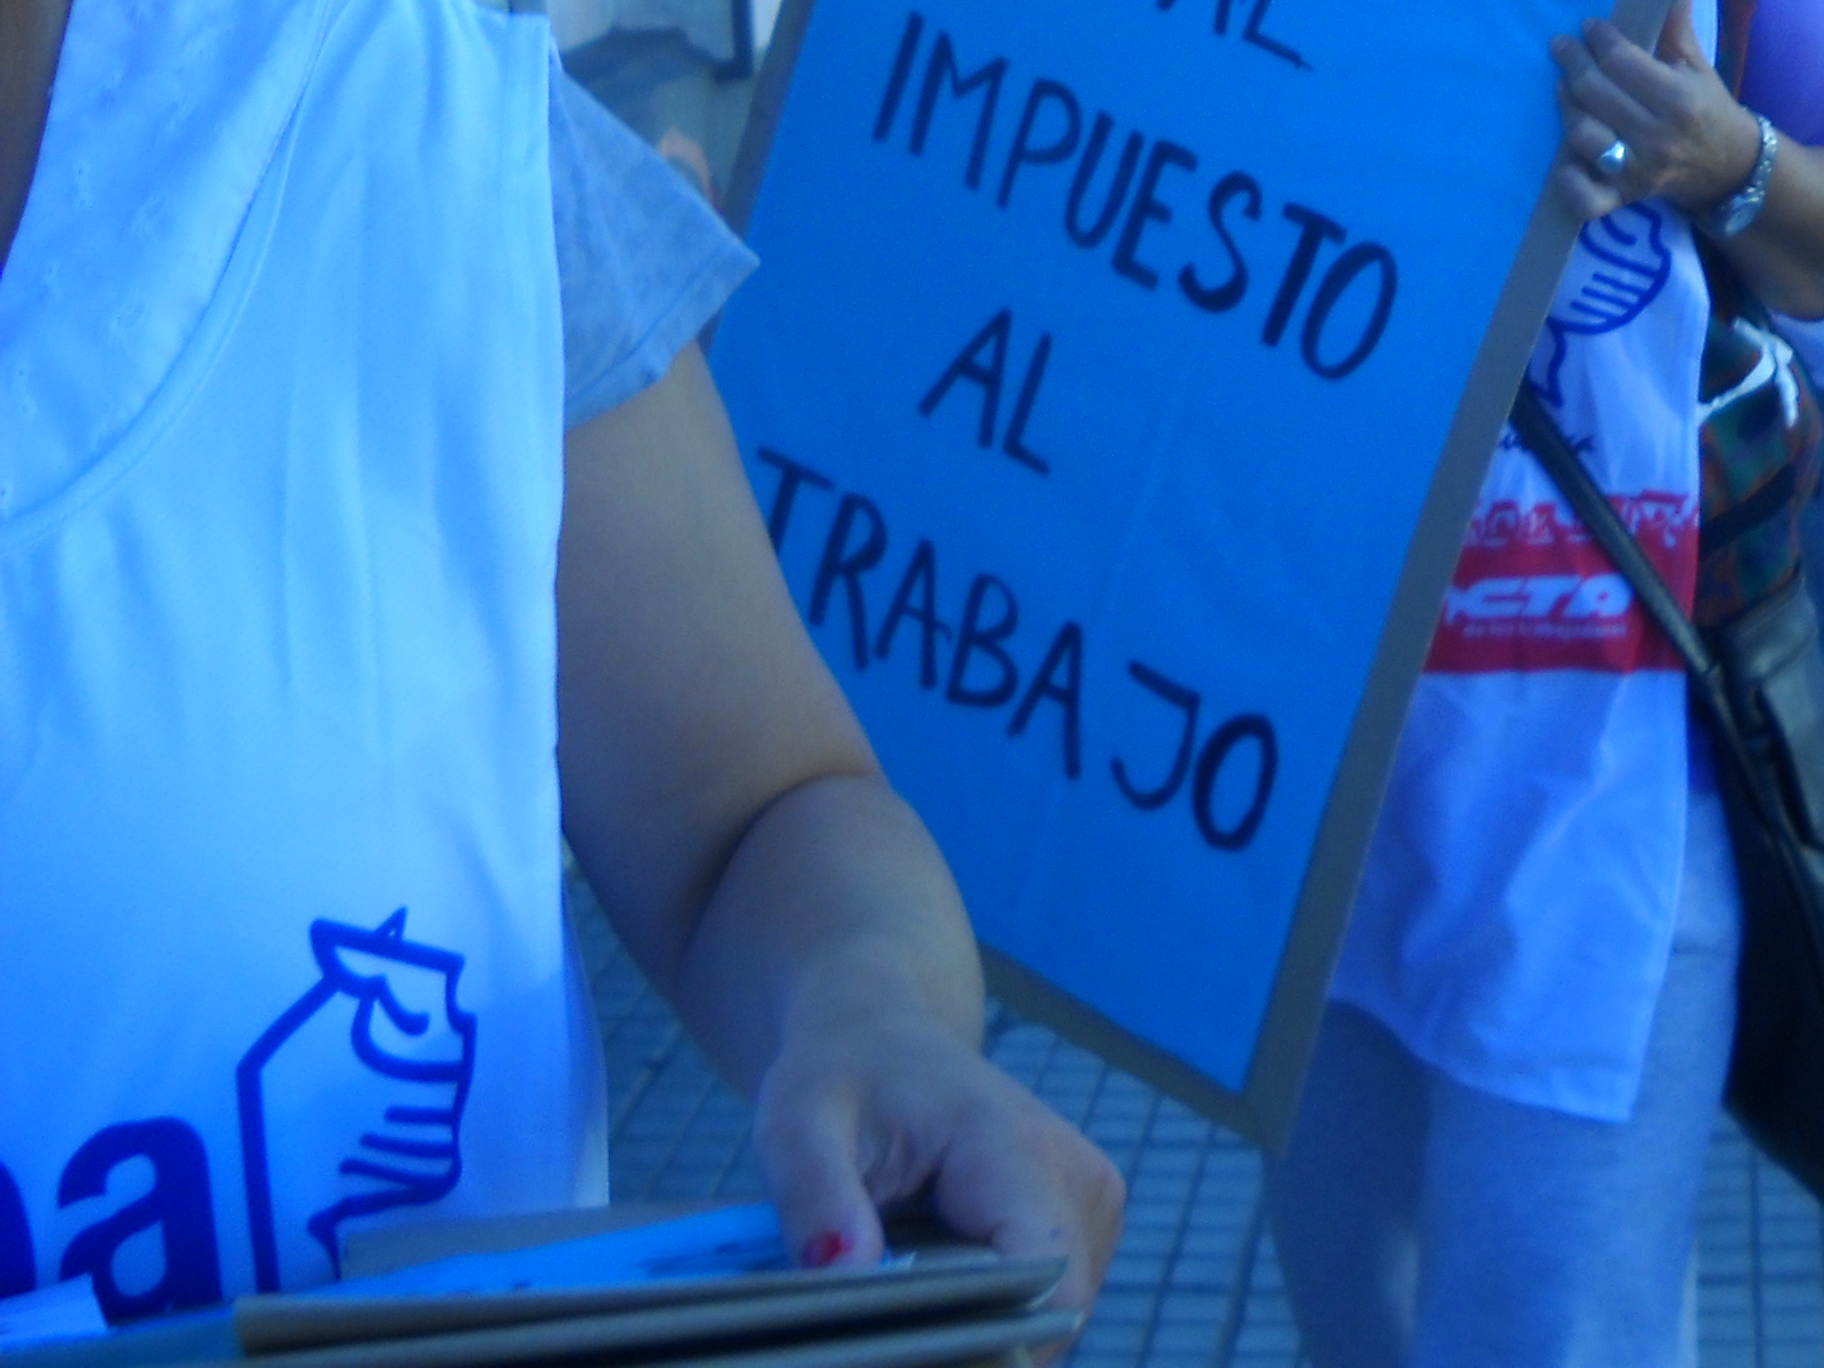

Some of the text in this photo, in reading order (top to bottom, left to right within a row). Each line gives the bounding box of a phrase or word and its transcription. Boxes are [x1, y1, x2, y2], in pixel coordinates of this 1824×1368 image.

[872, 11, 1398, 381] IMPUESTO
[918, 309, 1051, 475] AL
[757, 446, 1278, 851] TRABAJO
